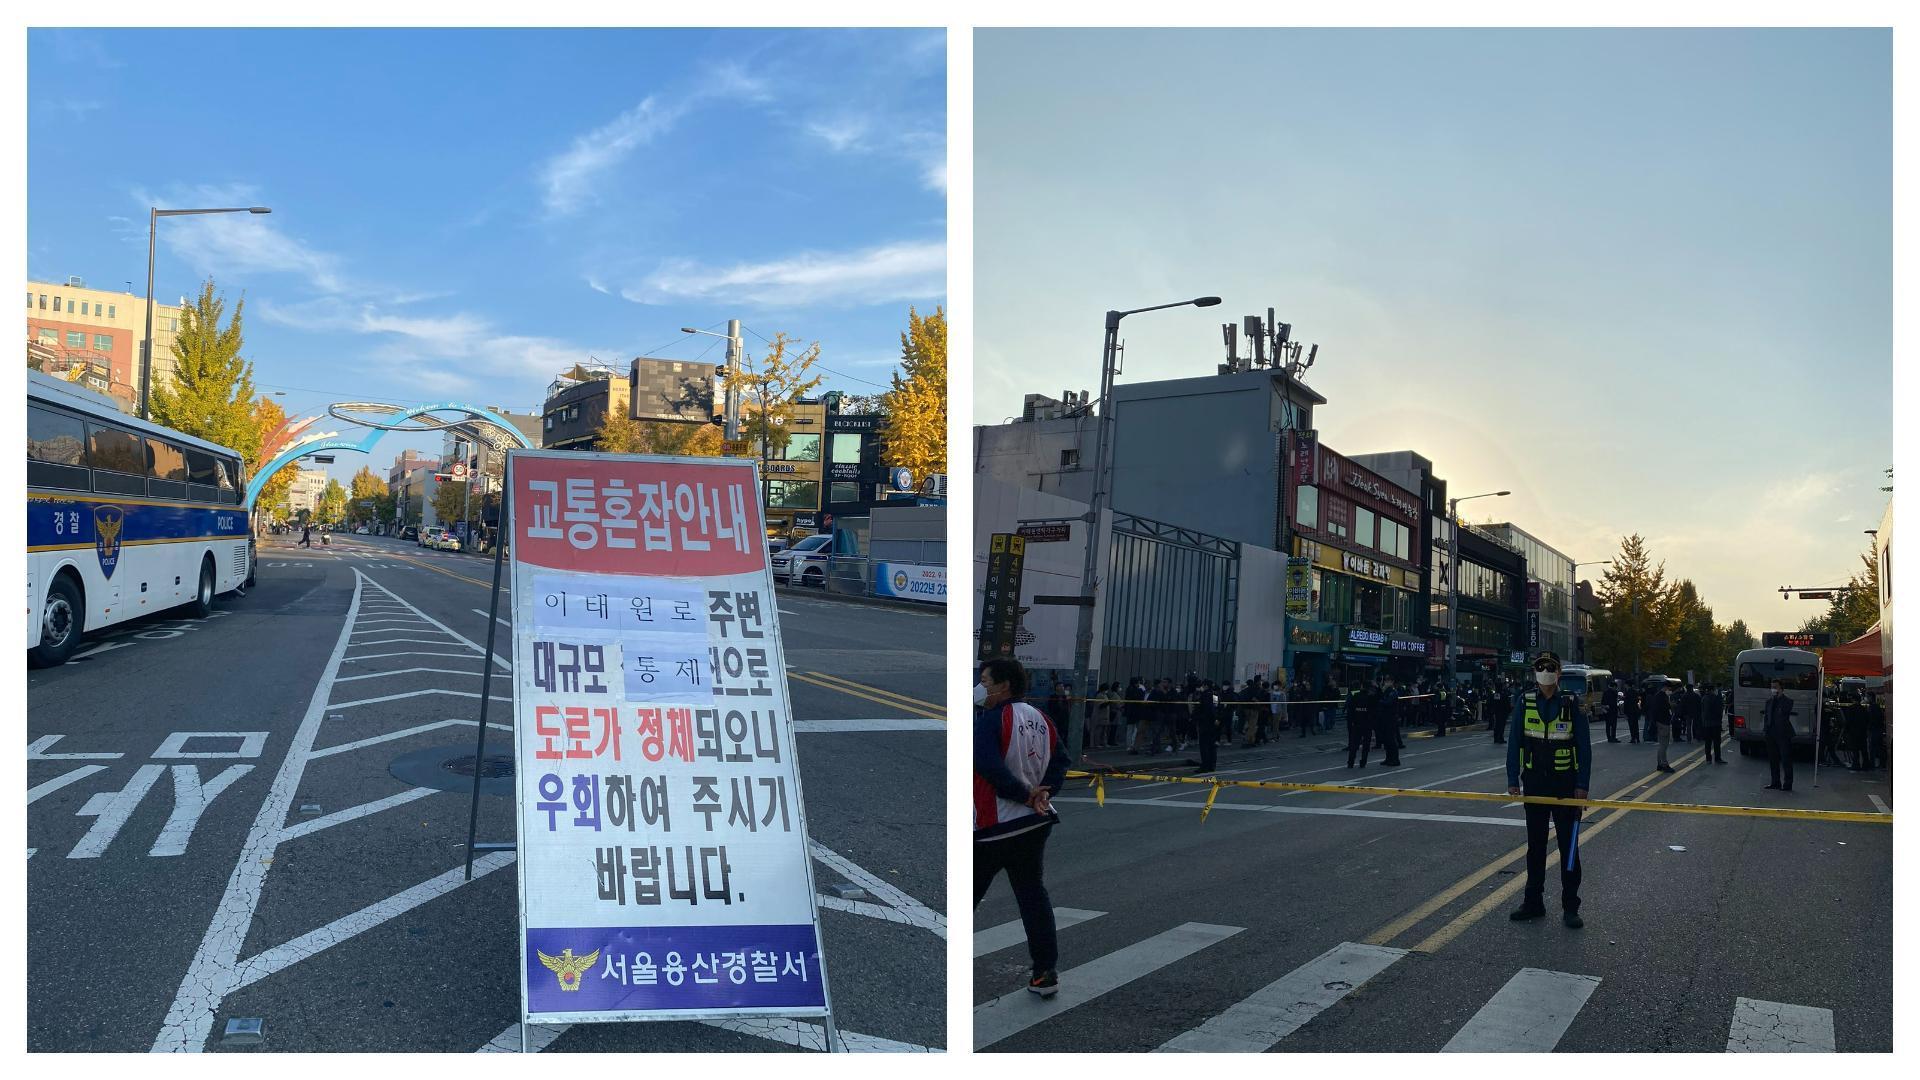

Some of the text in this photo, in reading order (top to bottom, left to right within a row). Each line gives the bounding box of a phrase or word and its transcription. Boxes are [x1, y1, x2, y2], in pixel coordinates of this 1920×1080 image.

[54, 511, 80, 535] 경찰
[217, 516, 234, 531] POLICE
[527, 478, 751, 554] 교통혼잡안내
[102, 557, 115, 567] POLICE
[910, 580, 935, 595] 2022년
[989, 575, 999, 615] 이태원
[1007, 576, 1017, 616] 이태원
[708, 590, 764, 639] 주변
[1369, 632, 1385, 642] KEBAB
[1391, 640, 1407, 650] EDIYA
[1407, 641, 1425, 652] COFFEE
[532, 640, 608, 694] 대규모
[633, 655, 700, 686] 통제
[534, 705, 782, 763] 도로가 정체되오니
[535, 772, 791, 833] 우회하여 주시기
[595, 845, 745, 906] 바랍니다.
[601, 950, 808, 986] 서울용산경찰서
